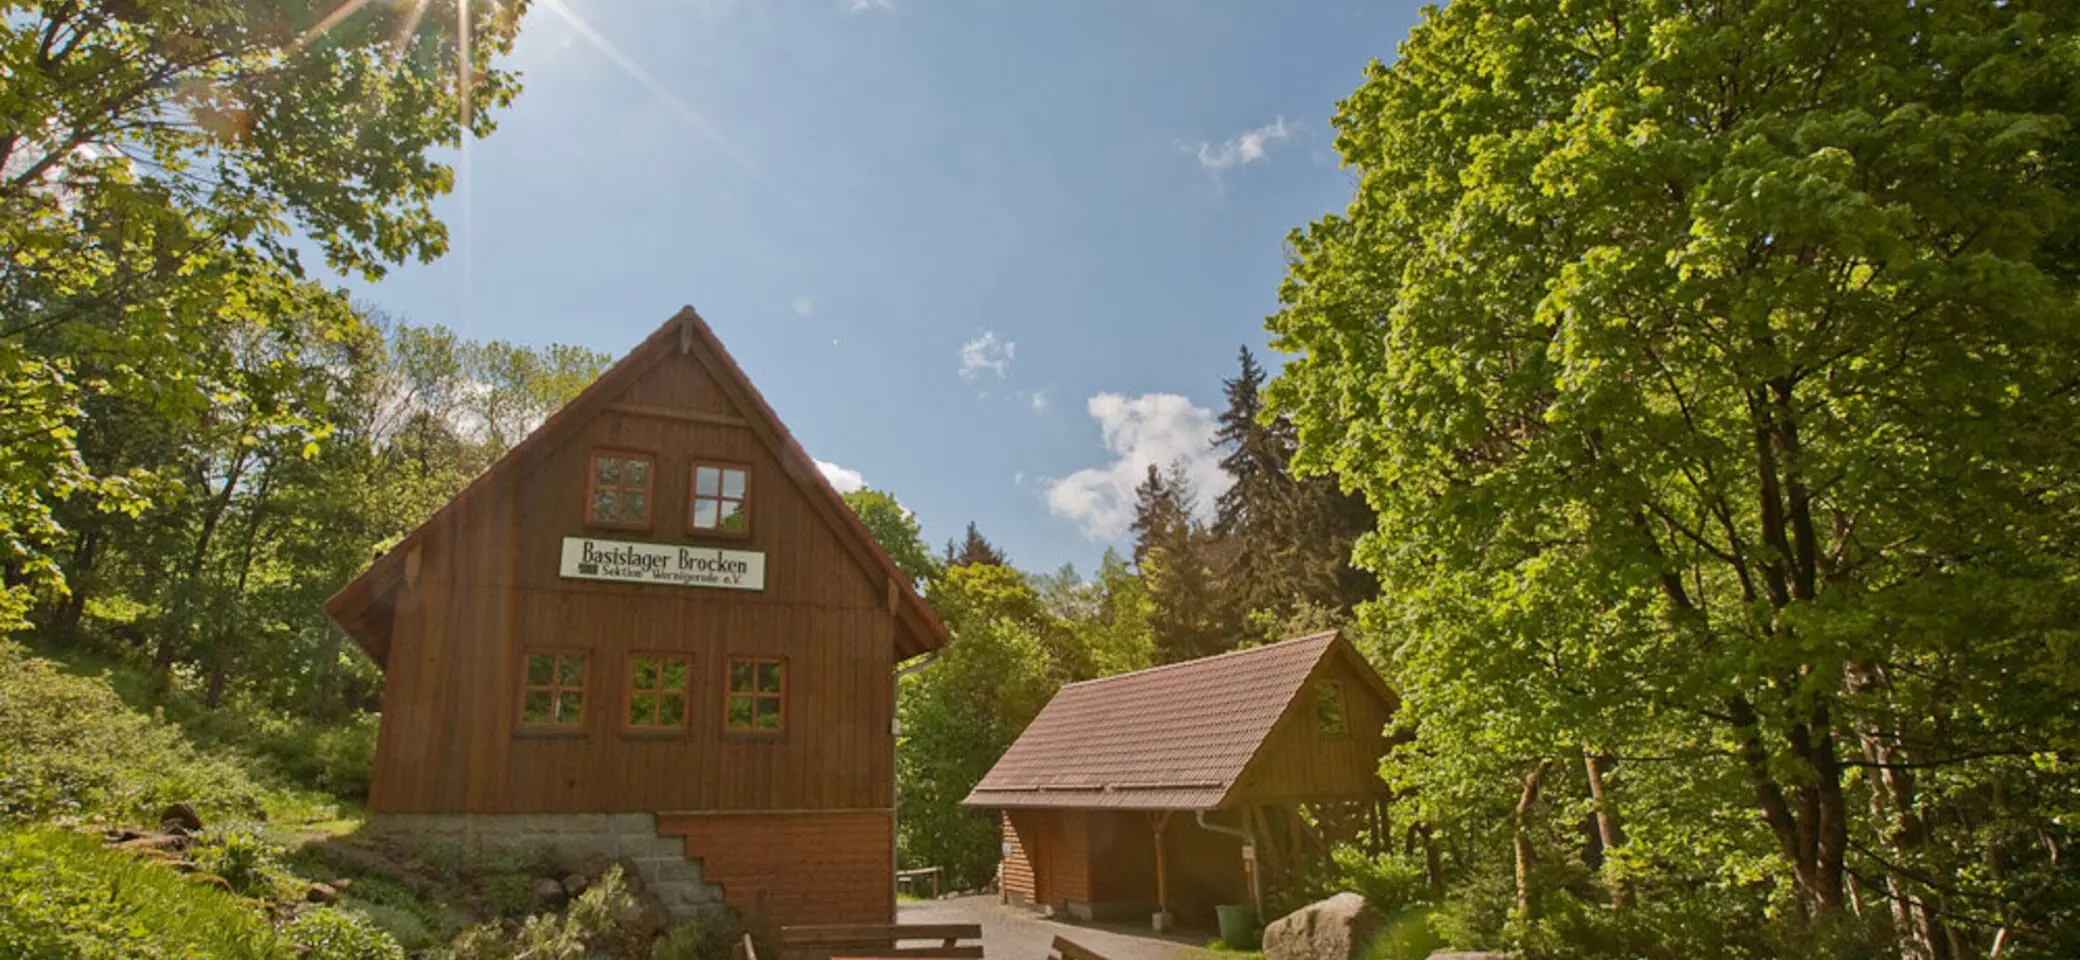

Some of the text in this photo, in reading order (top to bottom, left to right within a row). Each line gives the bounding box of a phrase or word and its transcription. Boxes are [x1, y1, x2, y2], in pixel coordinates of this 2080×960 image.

[582, 541, 747, 574] Basislager Brocken
[602, 564, 642, 578] Sektion
